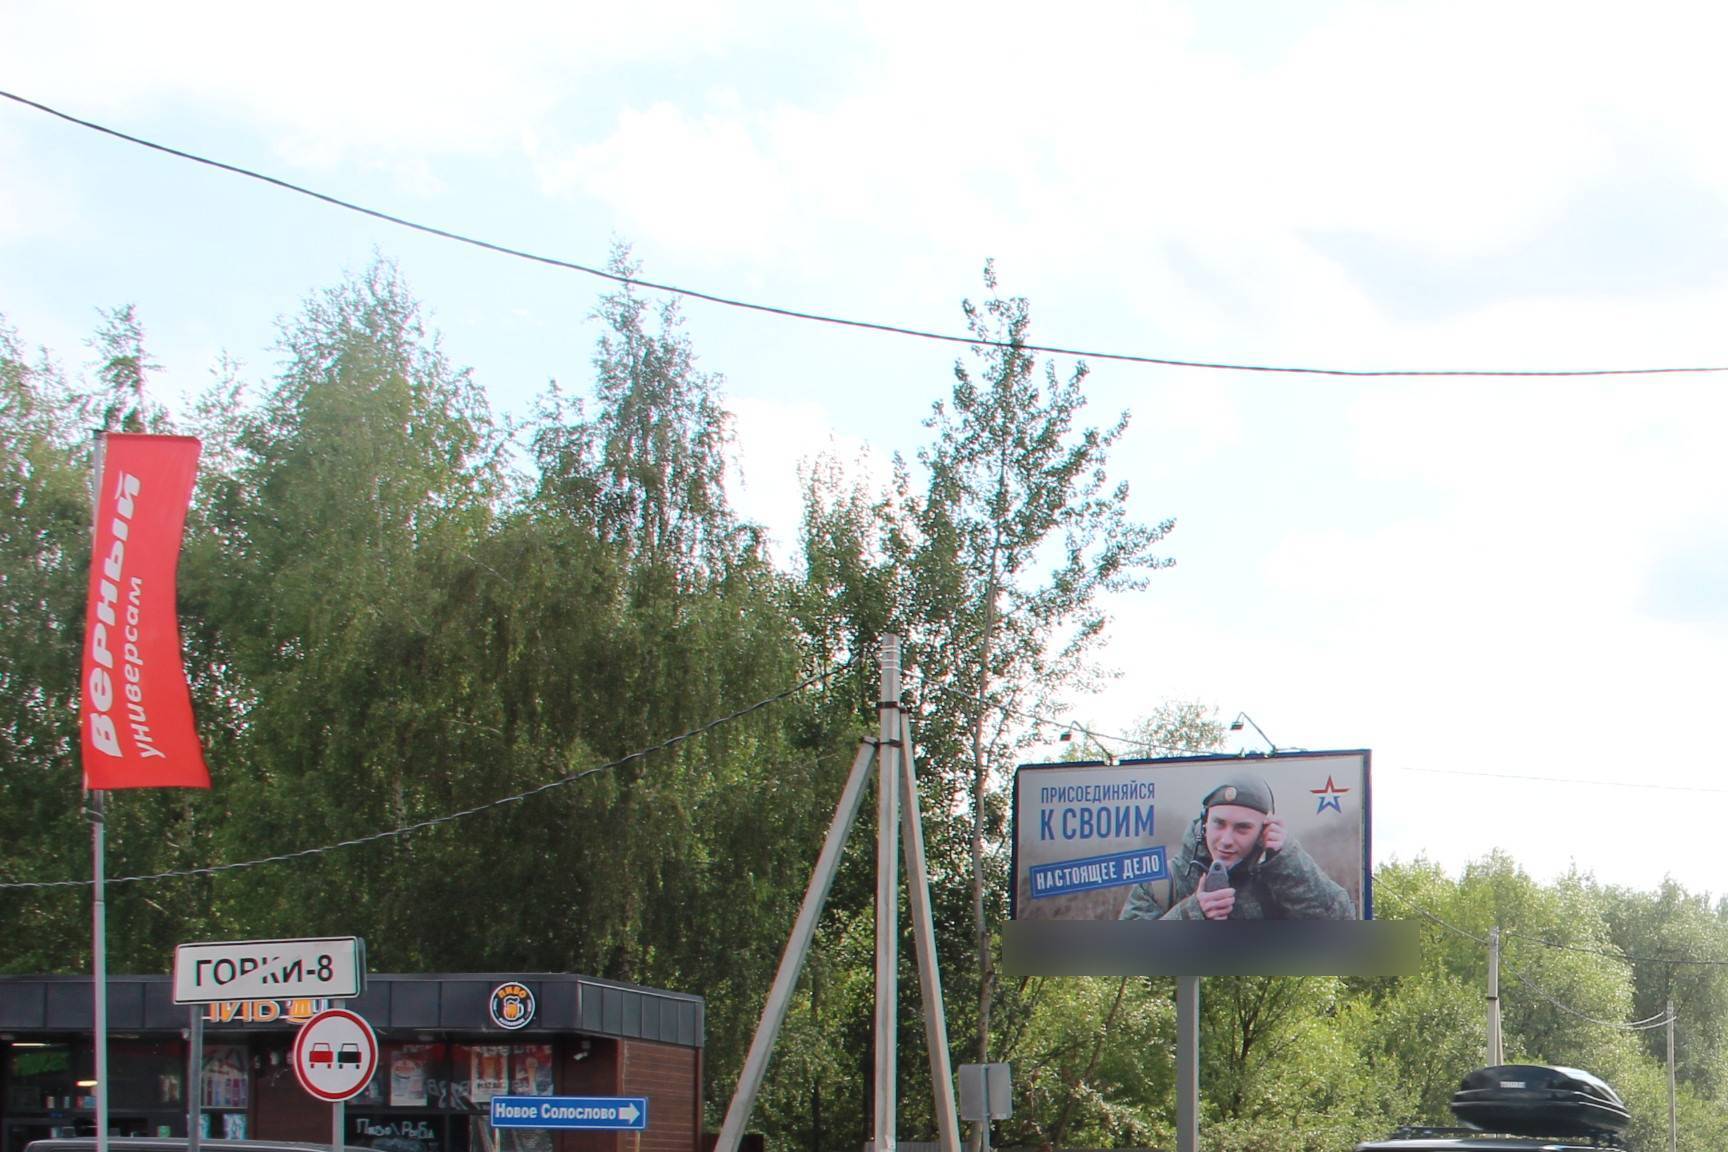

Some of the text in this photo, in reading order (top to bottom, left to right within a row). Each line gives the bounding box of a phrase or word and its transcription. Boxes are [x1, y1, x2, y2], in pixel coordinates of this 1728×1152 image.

[118, 576, 166, 760] универсам
[1040, 780, 1156, 804] ПРИСОЕДИНЯЙСЯ
[1039, 804, 1156, 841] К СВОИМ
[1035, 853, 1160, 891] НАСТОЯЩЕЕ ДЕЛО
[195, 954, 334, 988] ГОРКИ-8
[495, 1104, 617, 1121] Новое Солослово
